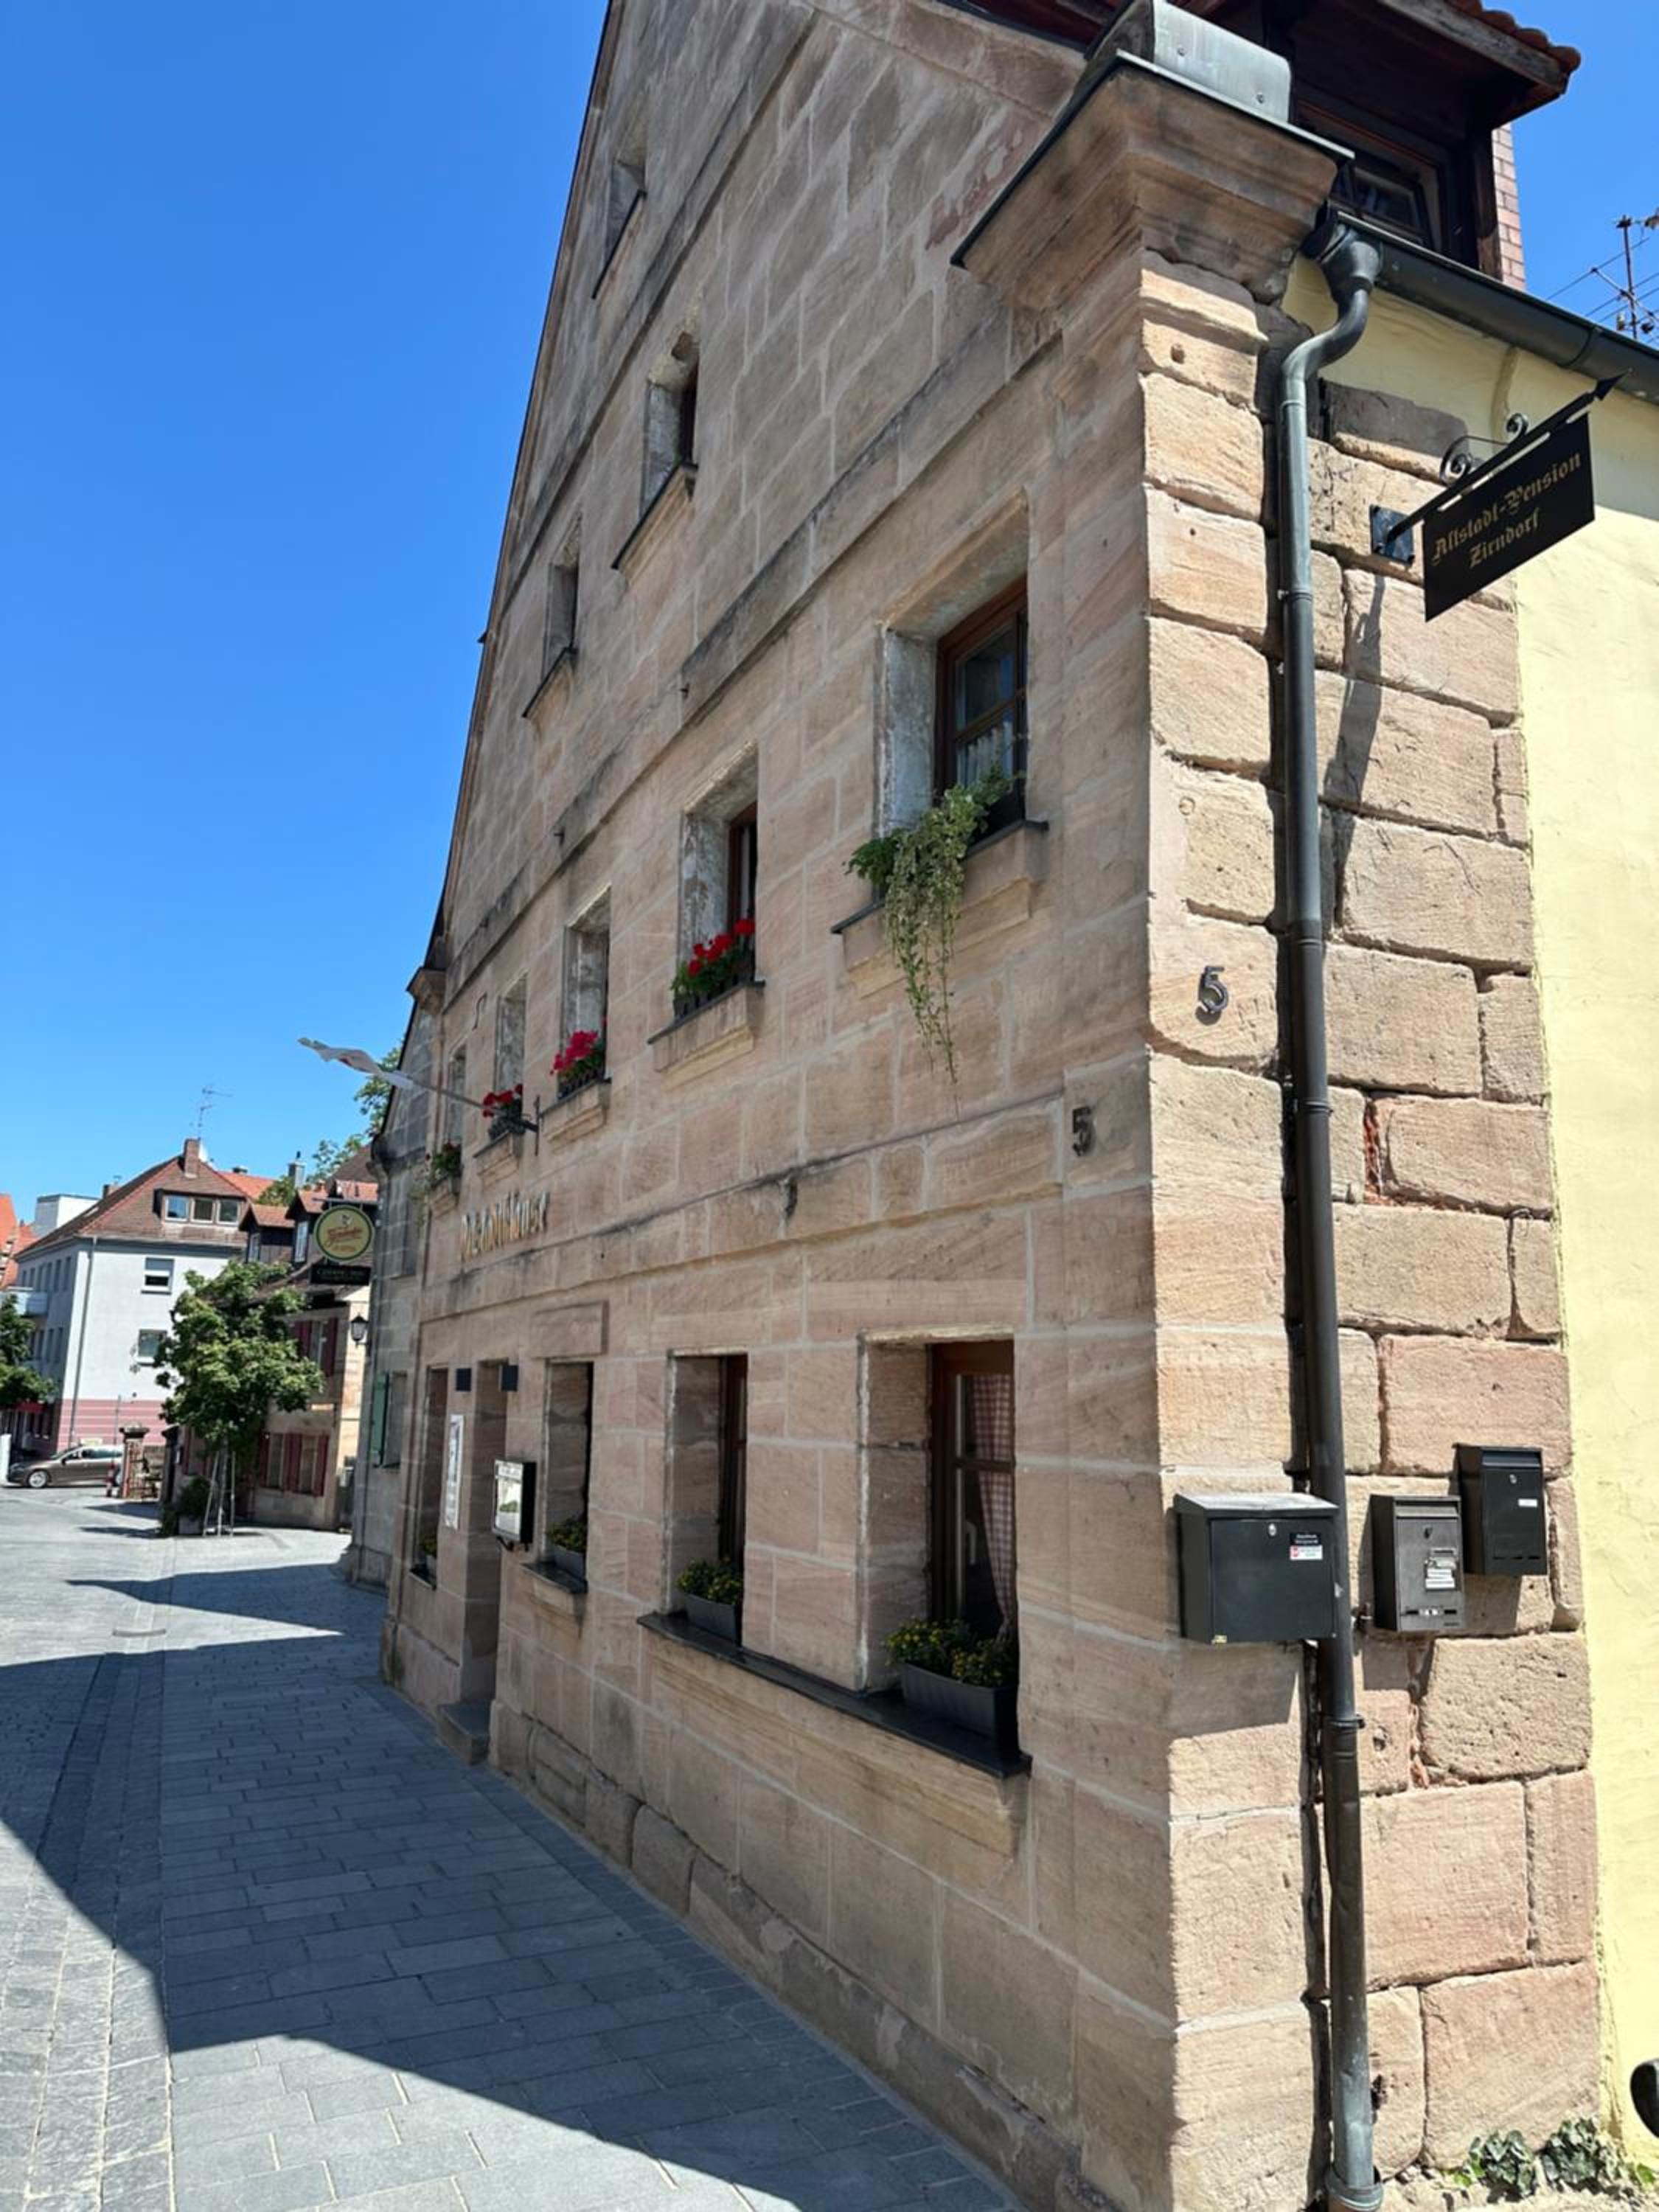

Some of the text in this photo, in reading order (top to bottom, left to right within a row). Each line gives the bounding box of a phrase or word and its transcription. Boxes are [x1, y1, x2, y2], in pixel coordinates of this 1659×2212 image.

[1433, 453, 1581, 566] Altstadt-Pension
[1468, 508, 1540, 568] Zirndorf
[1197, 965, 1229, 1018] 5
[1071, 1107, 1093, 1157] 5
